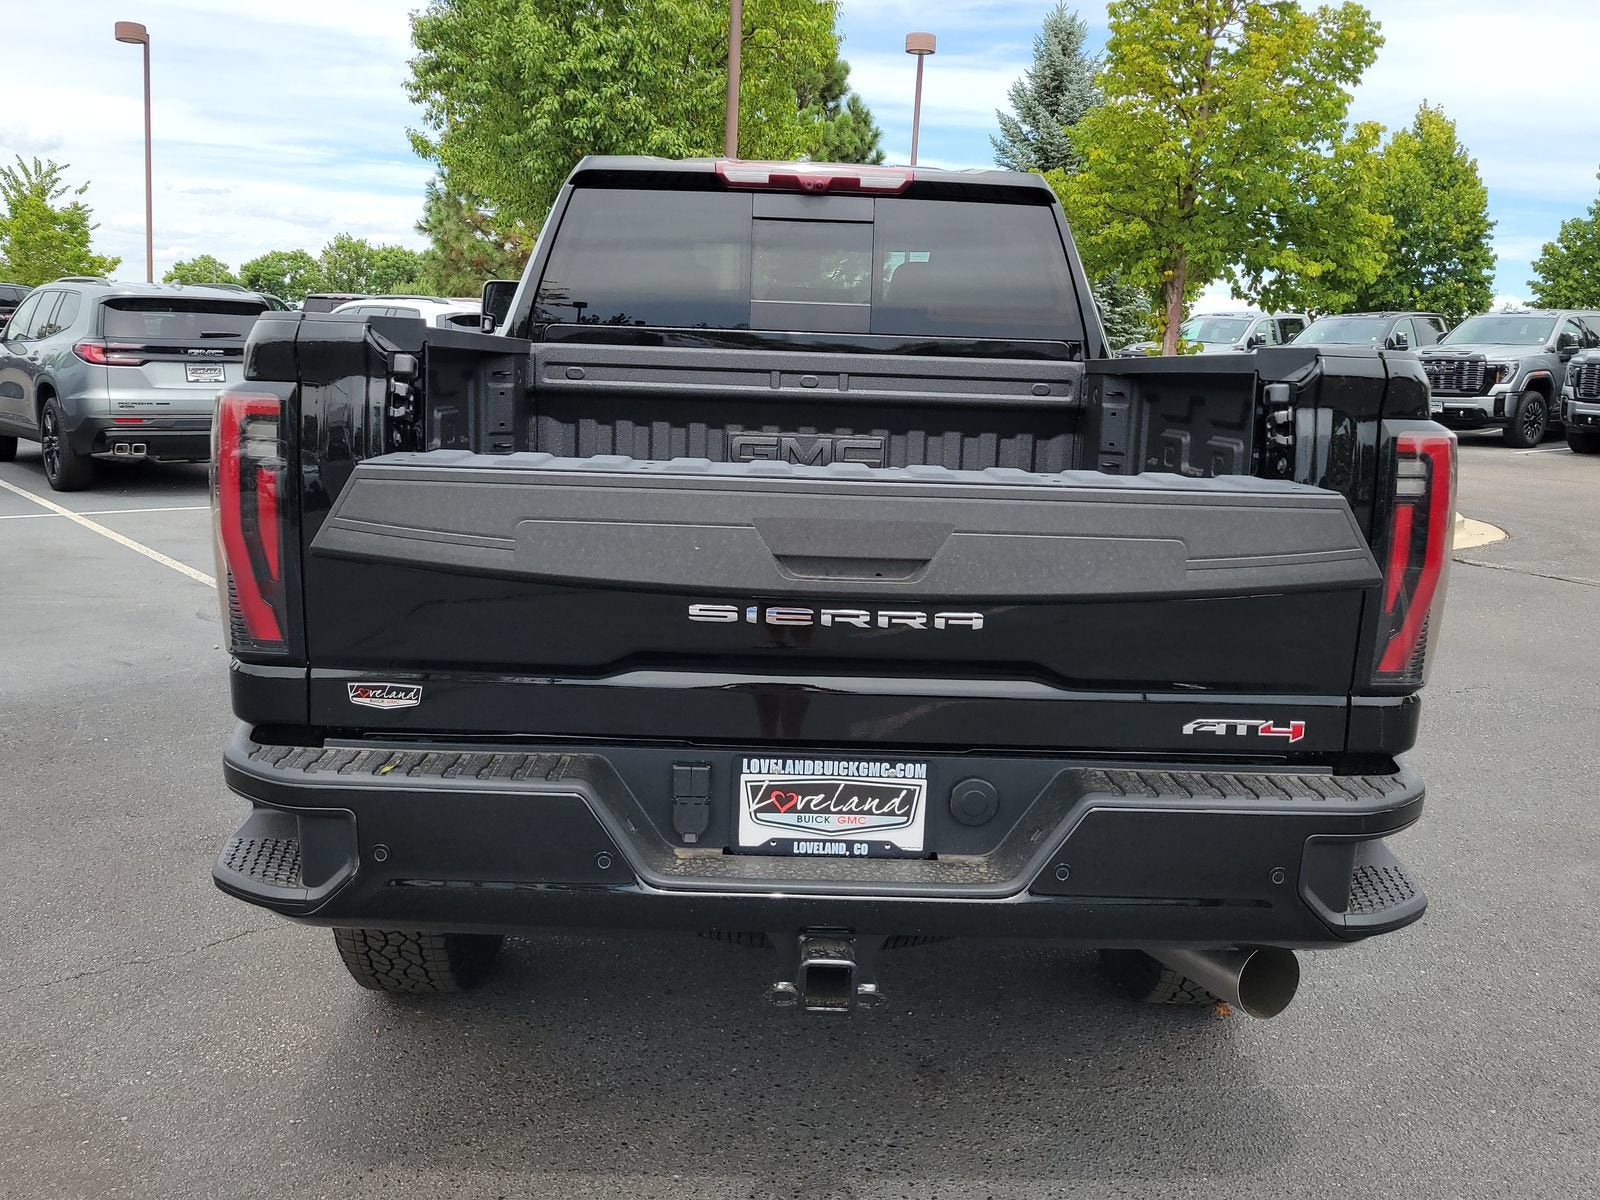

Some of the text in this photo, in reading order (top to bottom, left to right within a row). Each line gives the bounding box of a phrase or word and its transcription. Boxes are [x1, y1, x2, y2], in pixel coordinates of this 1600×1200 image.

[187, 349, 224, 357] GMC
[731, 436, 882, 469] GMC
[688, 604, 984, 630] SIERRA
[350, 683, 418, 699] Loveland
[1182, 719, 1305, 743] AT4
[742, 759, 927, 779] LOVELANDBUICKGMC.COM
[750, 780, 910, 815] Loveland
[796, 815, 867, 825] BUICK GMC
[793, 842, 869, 856] LOVELAND, CO
